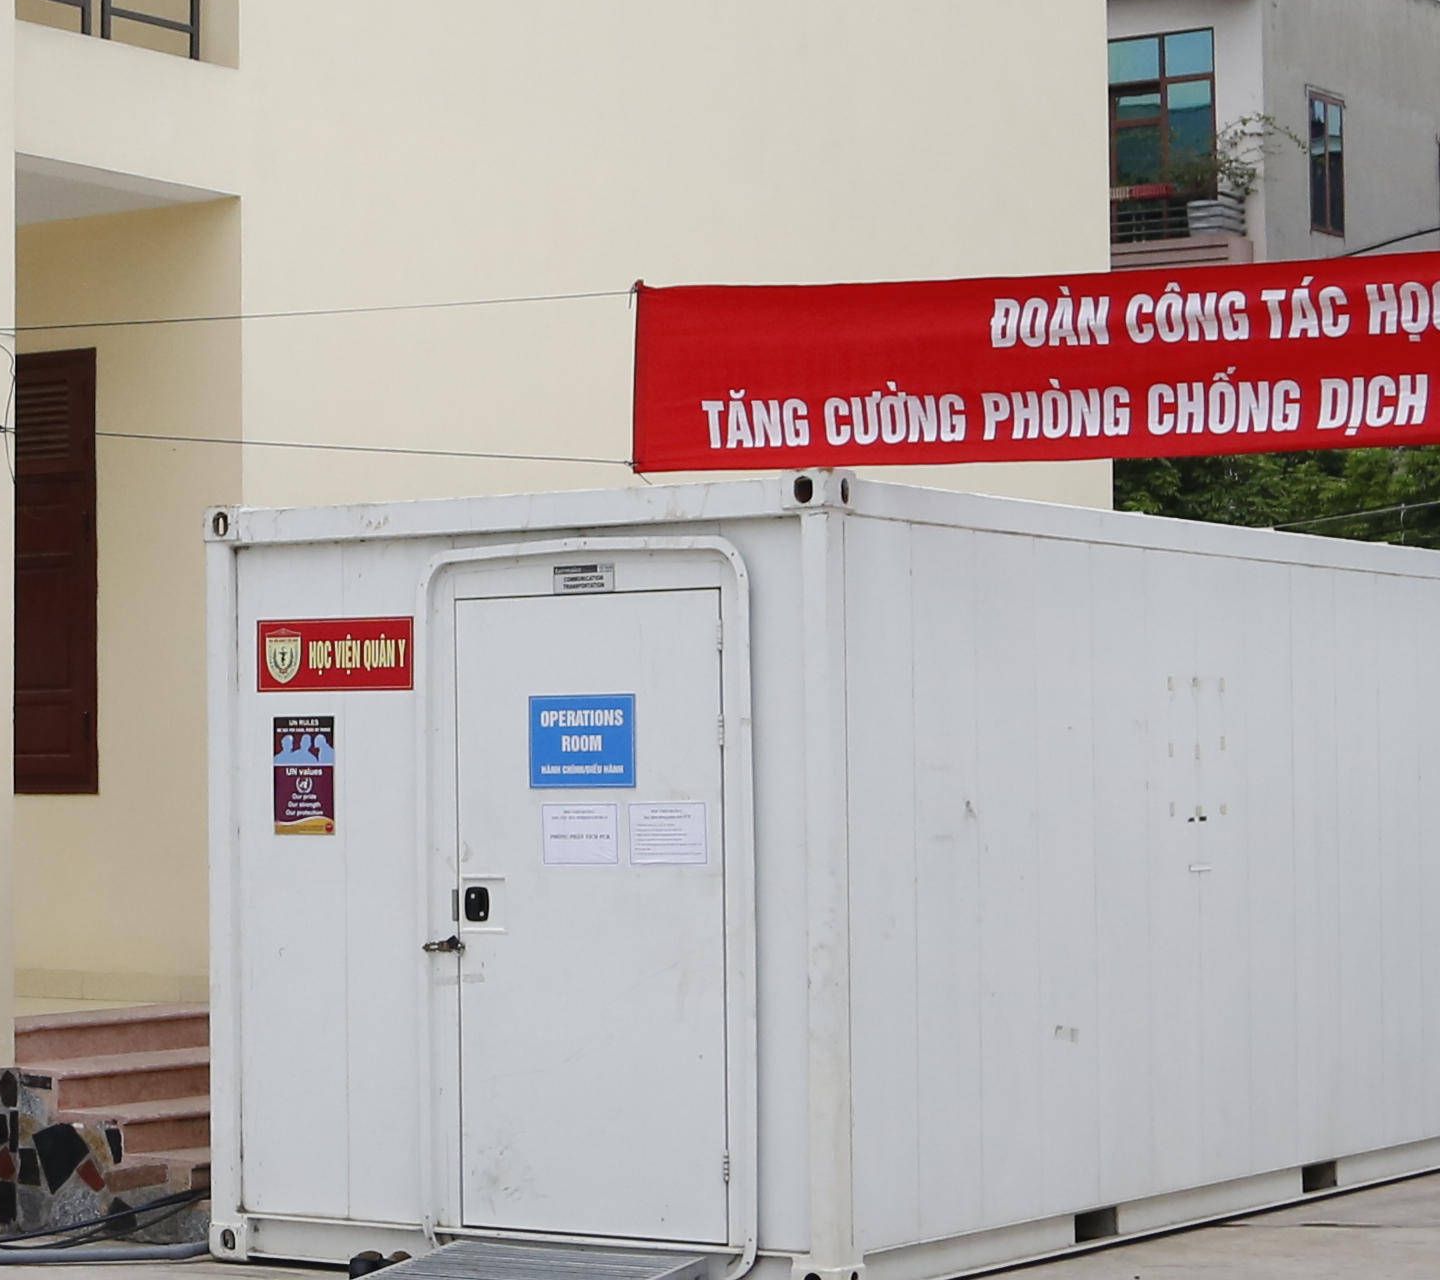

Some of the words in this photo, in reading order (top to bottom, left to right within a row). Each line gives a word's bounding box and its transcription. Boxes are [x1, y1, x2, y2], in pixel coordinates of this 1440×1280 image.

[990, 285, 1110, 348] ĐOÀN
[1125, 282, 1250, 344] CÔNG
[1260, 275, 1350, 340] TÁC
[701, 389, 810, 449] TĂNG
[823, 380, 966, 446] CƯỜNG
[981, 378, 1131, 441] PHÒNG
[1147, 365, 1301, 436] CHỐNG
[1316, 373, 1428, 437] DỊCH
[309, 640, 332, 676] HỌC
[334, 633, 361, 676] VIỆN
[363, 633, 396, 672] QUÂN
[398, 638, 407, 668] Y
[540, 708, 624, 728] OPERATIONS
[561, 734, 603, 752] ROOM
[285, 767, 298, 776] UN
[299, 767, 323, 776] values
